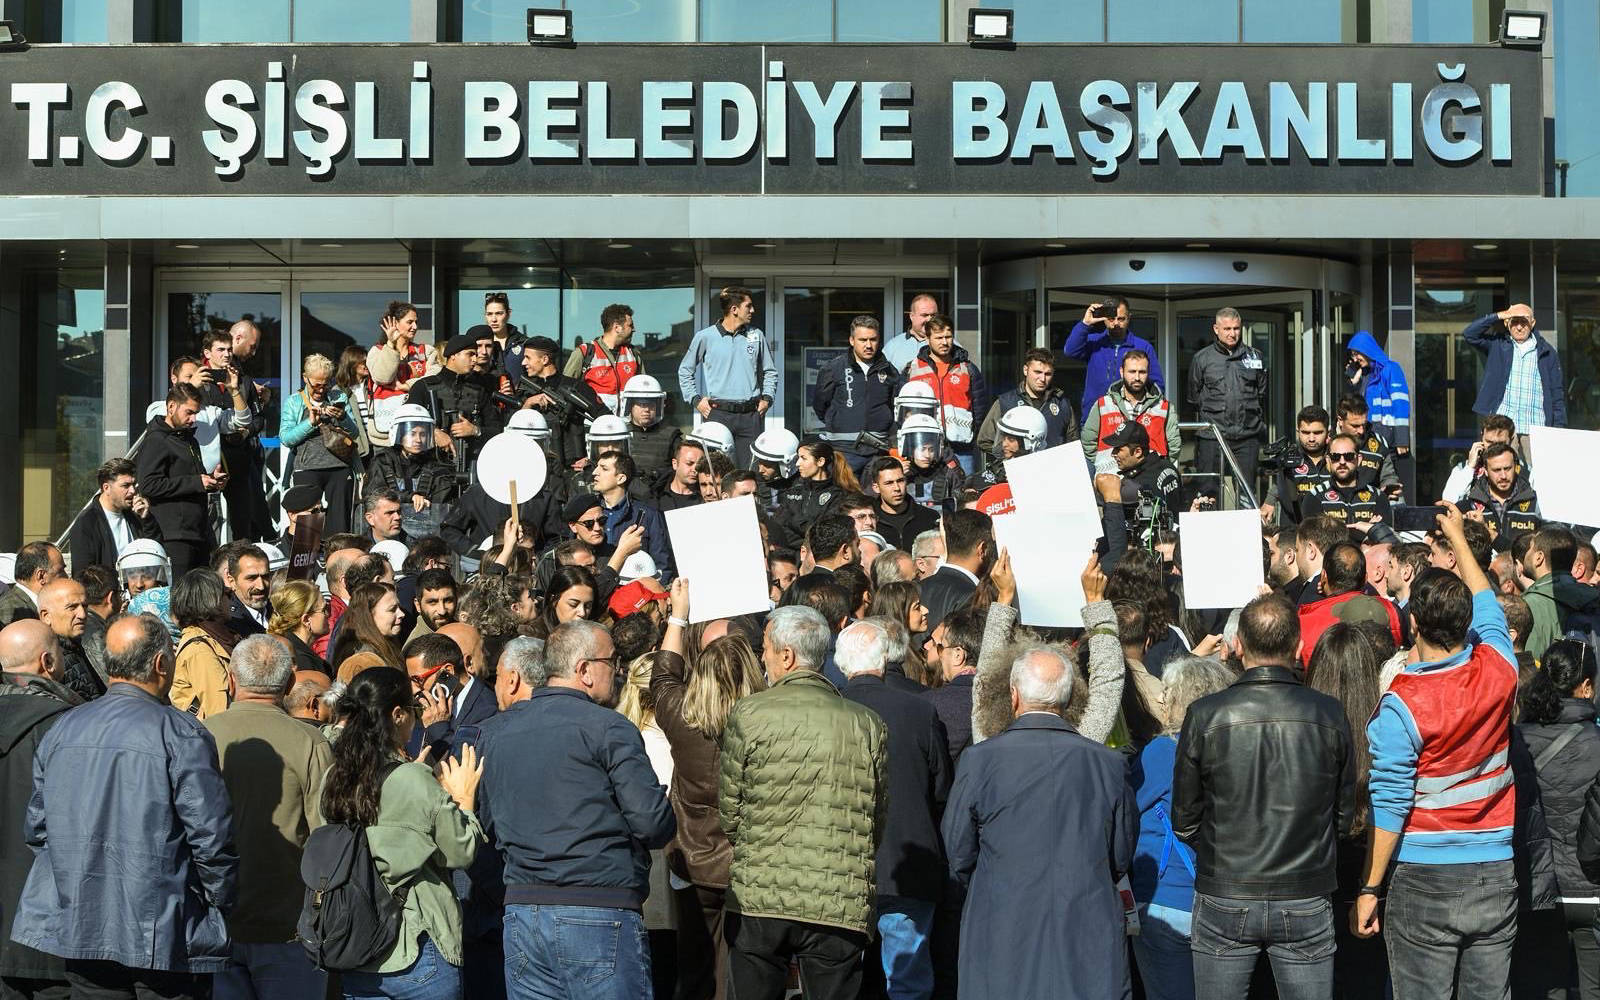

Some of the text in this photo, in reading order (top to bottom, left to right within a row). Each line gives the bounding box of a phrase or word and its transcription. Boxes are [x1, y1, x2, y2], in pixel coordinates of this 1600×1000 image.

[11, 61, 1513, 176] T.C. ŞİŞLİ BELEDİYE BAŞKANLIĞI
[1361, 460, 1380, 470] POLİ
